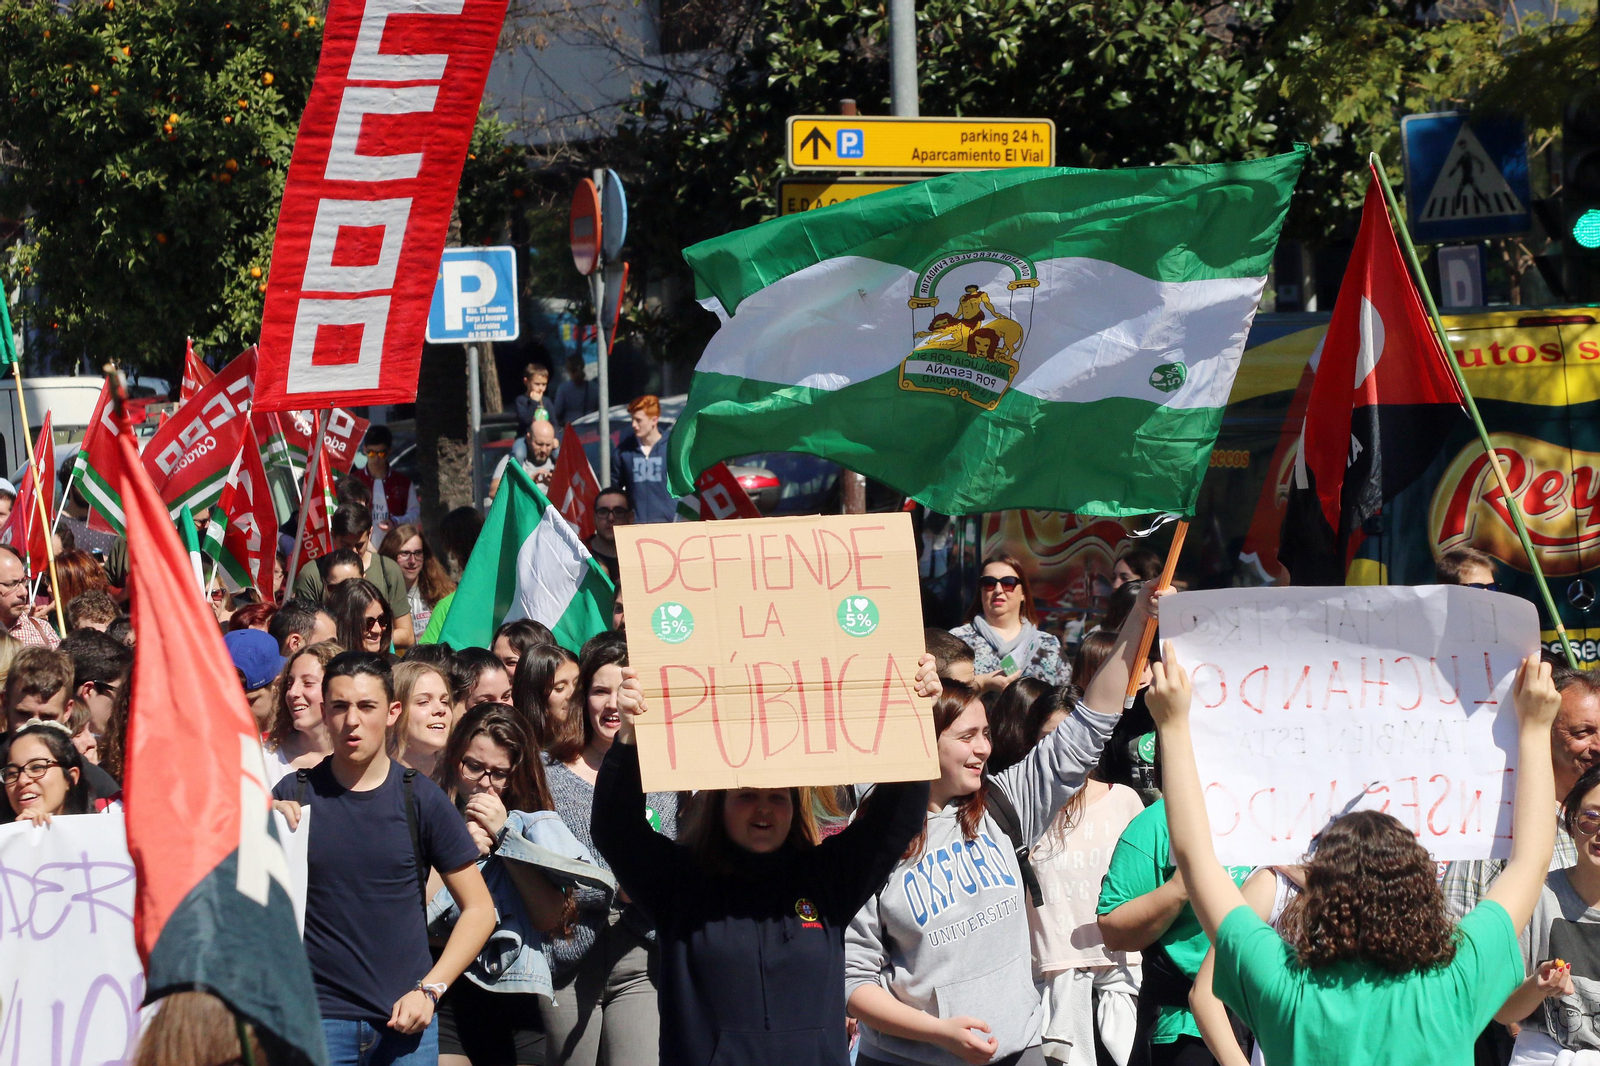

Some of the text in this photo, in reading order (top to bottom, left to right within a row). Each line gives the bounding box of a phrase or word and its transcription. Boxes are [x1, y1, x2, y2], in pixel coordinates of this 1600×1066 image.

[841, 132, 859, 155] P
[911, 148, 1044, 162] Aparcamiento El Vial
[960, 130, 1044, 145] parking 24 h.
[443, 260, 498, 331] P
[1455, 341, 1562, 368] utos
[1437, 447, 1600, 547] Rey
[635, 525, 891, 594] DEFIENDE
[660, 619, 688, 635] 5%
[739, 601, 786, 639] LA
[845, 612, 872, 627] 5%
[658, 651, 931, 770] PÚBLICA
[0, 850, 137, 941] DER
[902, 833, 1018, 928] OXFORD
[927, 894, 1020, 948] UNIVERSITY
